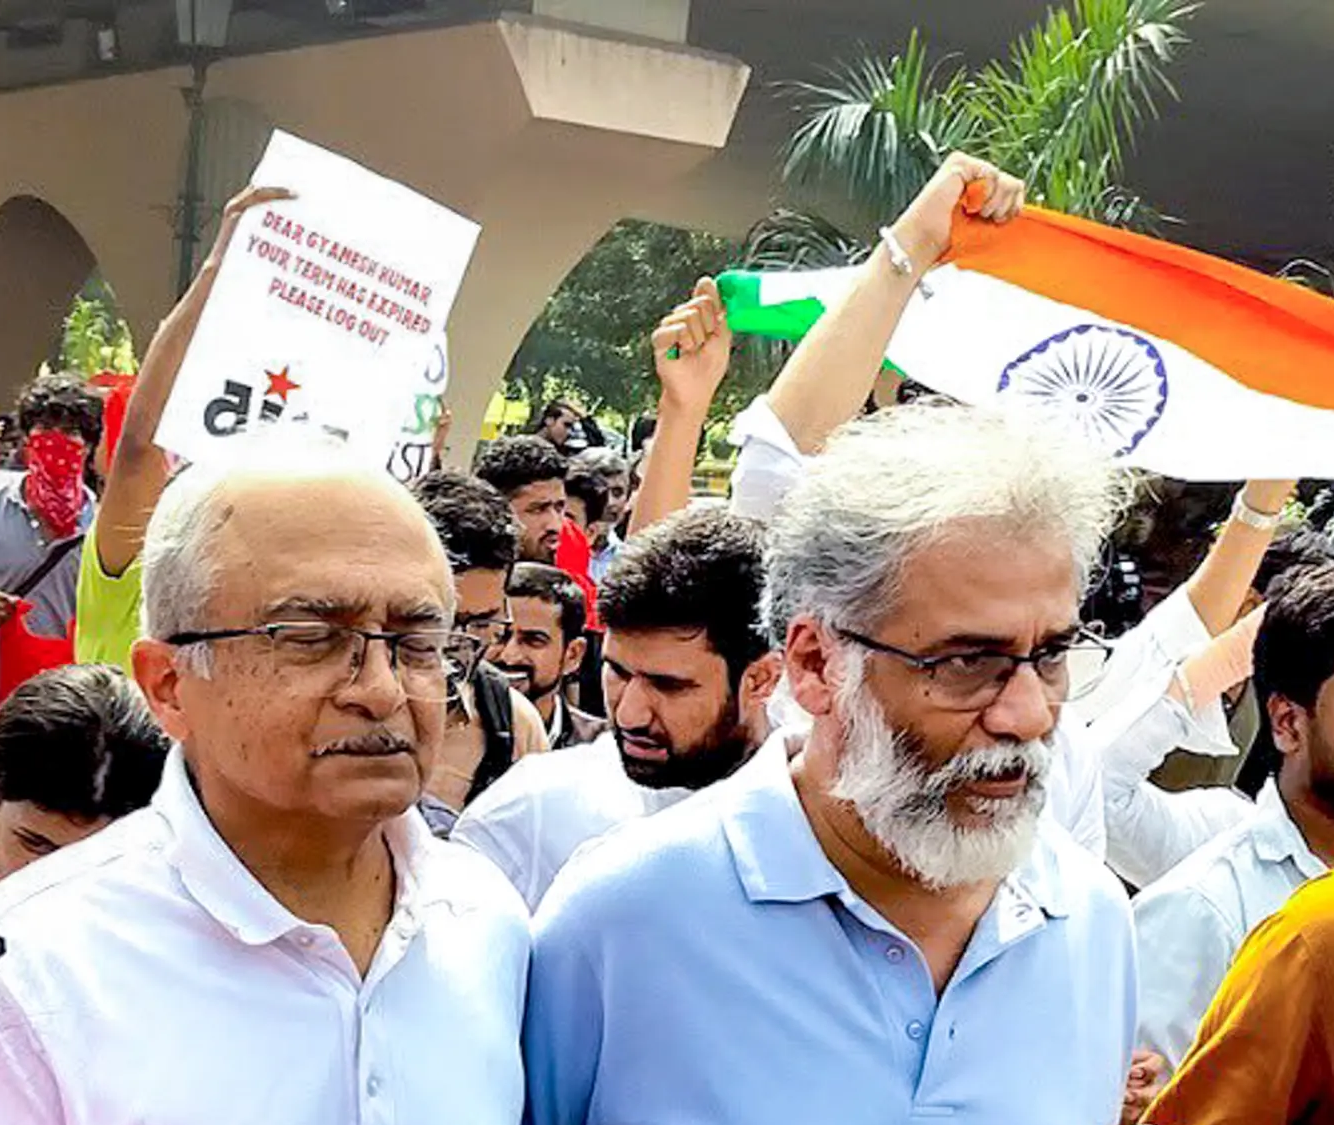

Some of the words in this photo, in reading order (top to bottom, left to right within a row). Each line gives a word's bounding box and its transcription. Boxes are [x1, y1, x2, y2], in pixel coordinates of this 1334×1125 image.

[246, 234, 292, 271] YOUR
[293, 255, 336, 290] TERM
[336, 276, 367, 304] HAS
[366, 291, 432, 334] EXPIRED
[262, 210, 305, 245] DEAR
[378, 266, 432, 307] KUMAR
[268, 276, 327, 318] PLEASE
[325, 303, 358, 332] LOG
[358, 319, 390, 346] OUT
